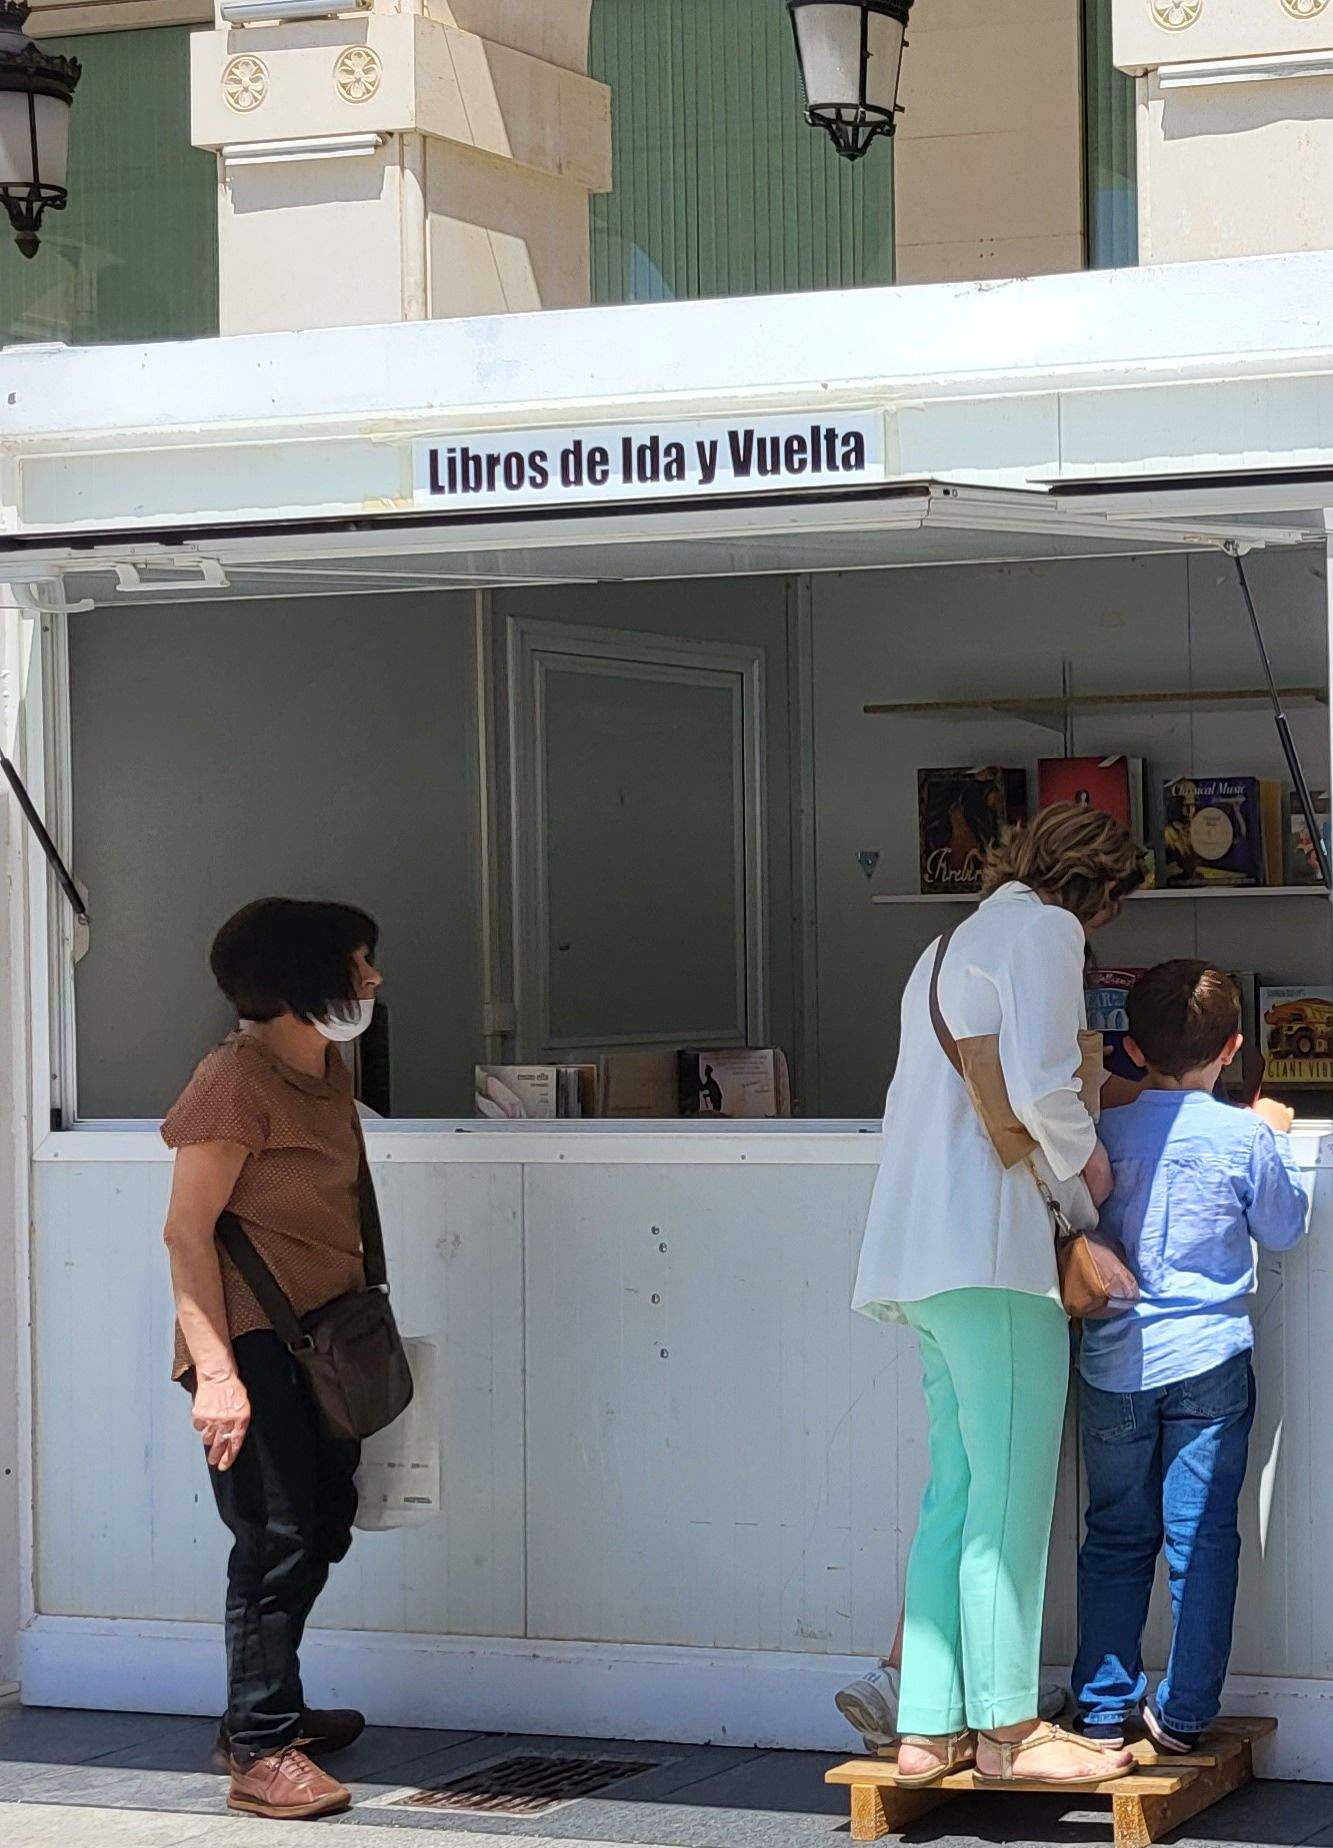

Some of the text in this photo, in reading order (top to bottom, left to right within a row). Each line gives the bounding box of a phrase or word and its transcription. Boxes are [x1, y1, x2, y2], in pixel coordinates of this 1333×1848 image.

[428, 425, 867, 495] Libros de Ida y Vuelta
[1216, 781, 1247, 797] Music
